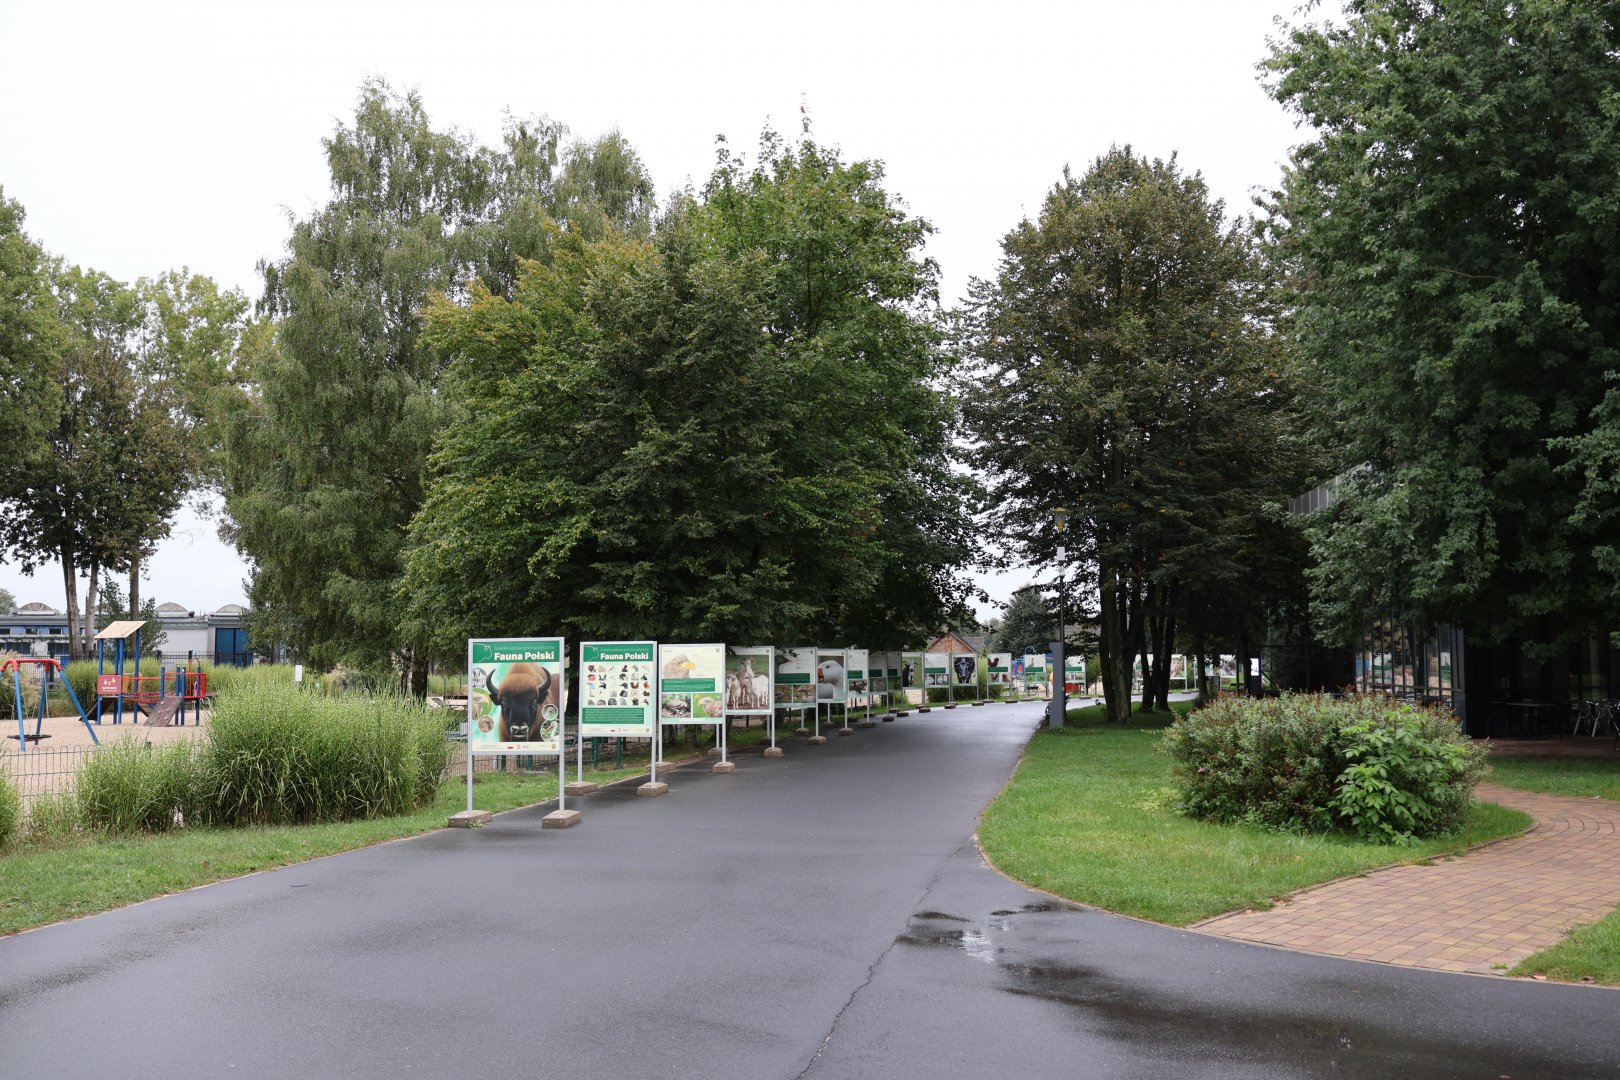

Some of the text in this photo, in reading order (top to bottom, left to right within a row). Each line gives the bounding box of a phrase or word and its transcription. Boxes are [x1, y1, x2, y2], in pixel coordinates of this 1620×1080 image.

[494, 651, 554, 660] Fauna Polski
[625, 652, 648, 660] Polski
